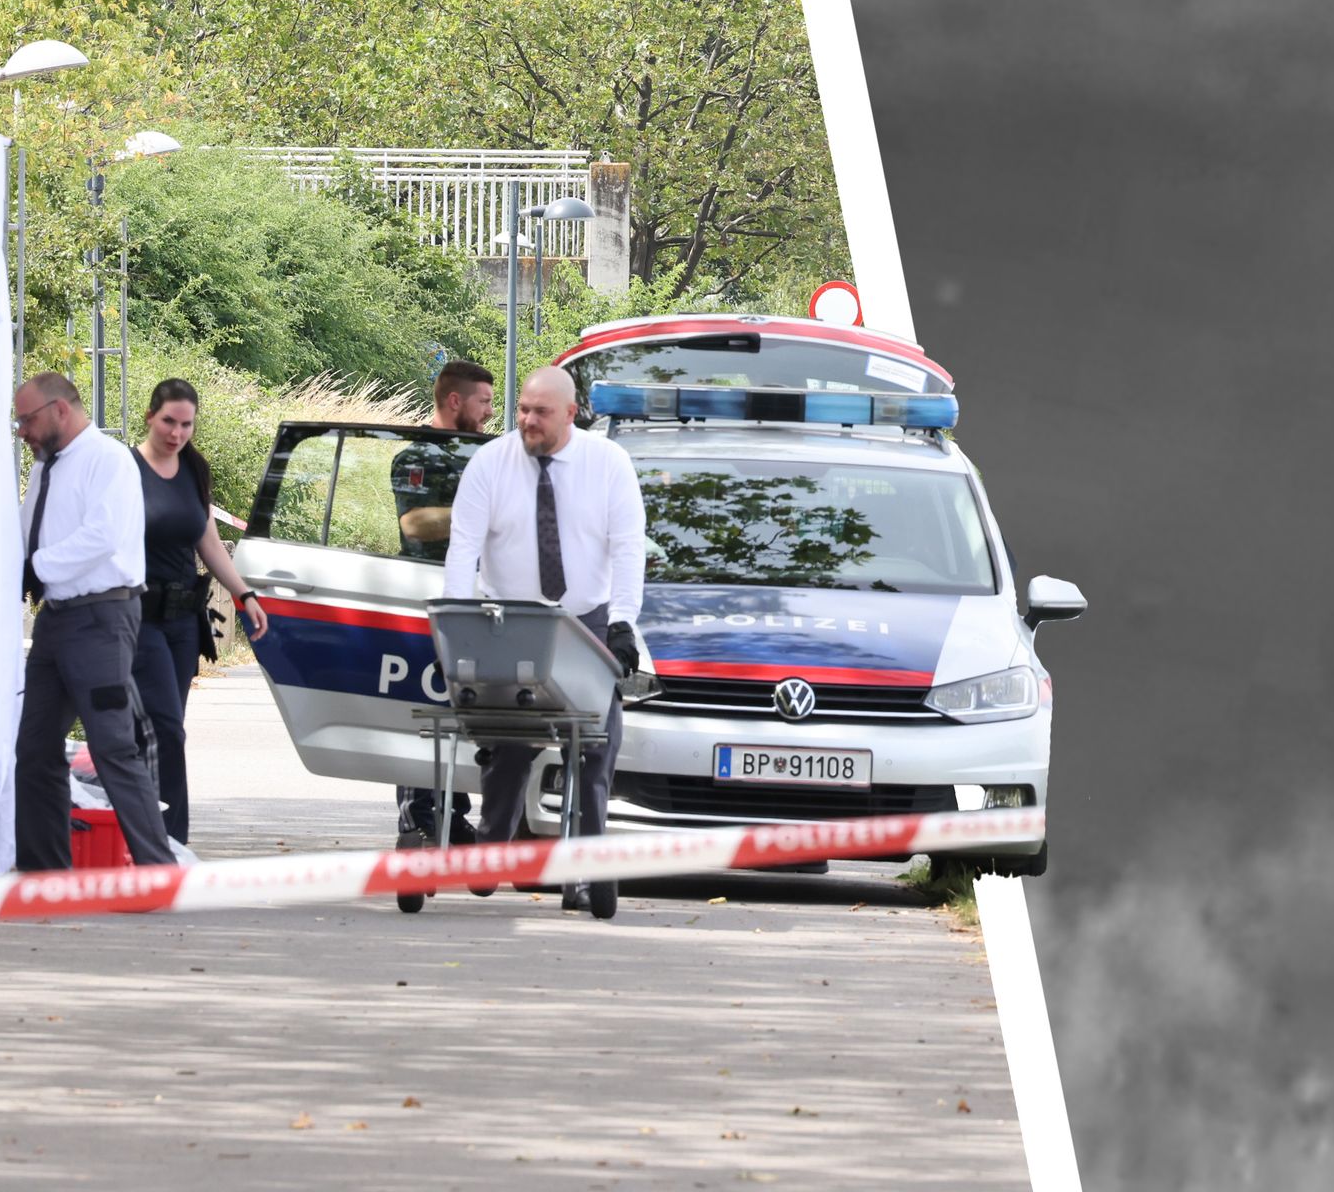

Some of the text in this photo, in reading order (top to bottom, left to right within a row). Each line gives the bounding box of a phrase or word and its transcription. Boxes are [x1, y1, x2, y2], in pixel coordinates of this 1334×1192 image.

[692, 613, 889, 635] POLIZEI
[743, 753, 770, 775] BP
[790, 755, 854, 779] 91108
